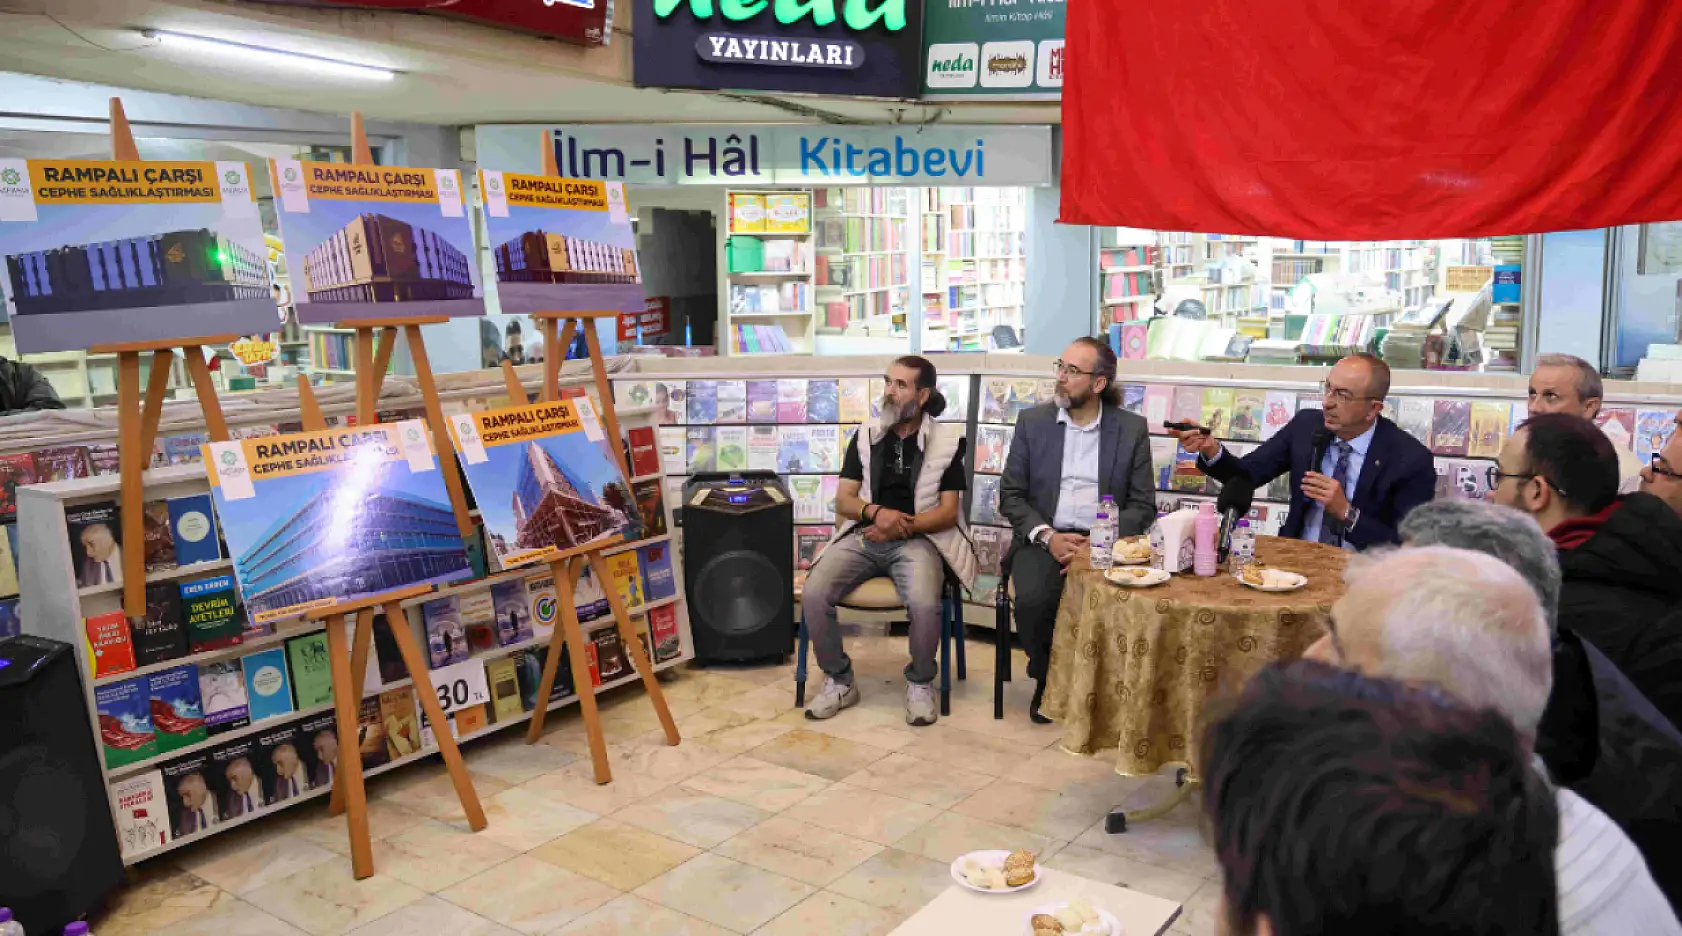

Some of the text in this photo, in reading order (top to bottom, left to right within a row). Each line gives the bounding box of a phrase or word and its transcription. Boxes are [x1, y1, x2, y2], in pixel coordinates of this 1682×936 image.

[708, 36, 853, 65] YAYINLARI
[932, 52, 973, 72] neda
[554, 129, 983, 177] İlm-i Hâl Kitabevi
[43, 167, 203, 185] RAMPALI ÇARŞI
[313, 167, 425, 188] RAMPALI ÇARŞI
[38, 187, 86, 198] CEPHE
[89, 186, 214, 200] SAĞLIKLAŞTIRMASI
[310, 184, 344, 195] CEPHE
[511, 178, 598, 198] RAMPALI ÇARŞI
[481, 410, 535, 429] RAMPALI
[255, 437, 334, 459] RAMPALI
[254, 459, 293, 474] CEPHE
[437, 679, 469, 709] 30
